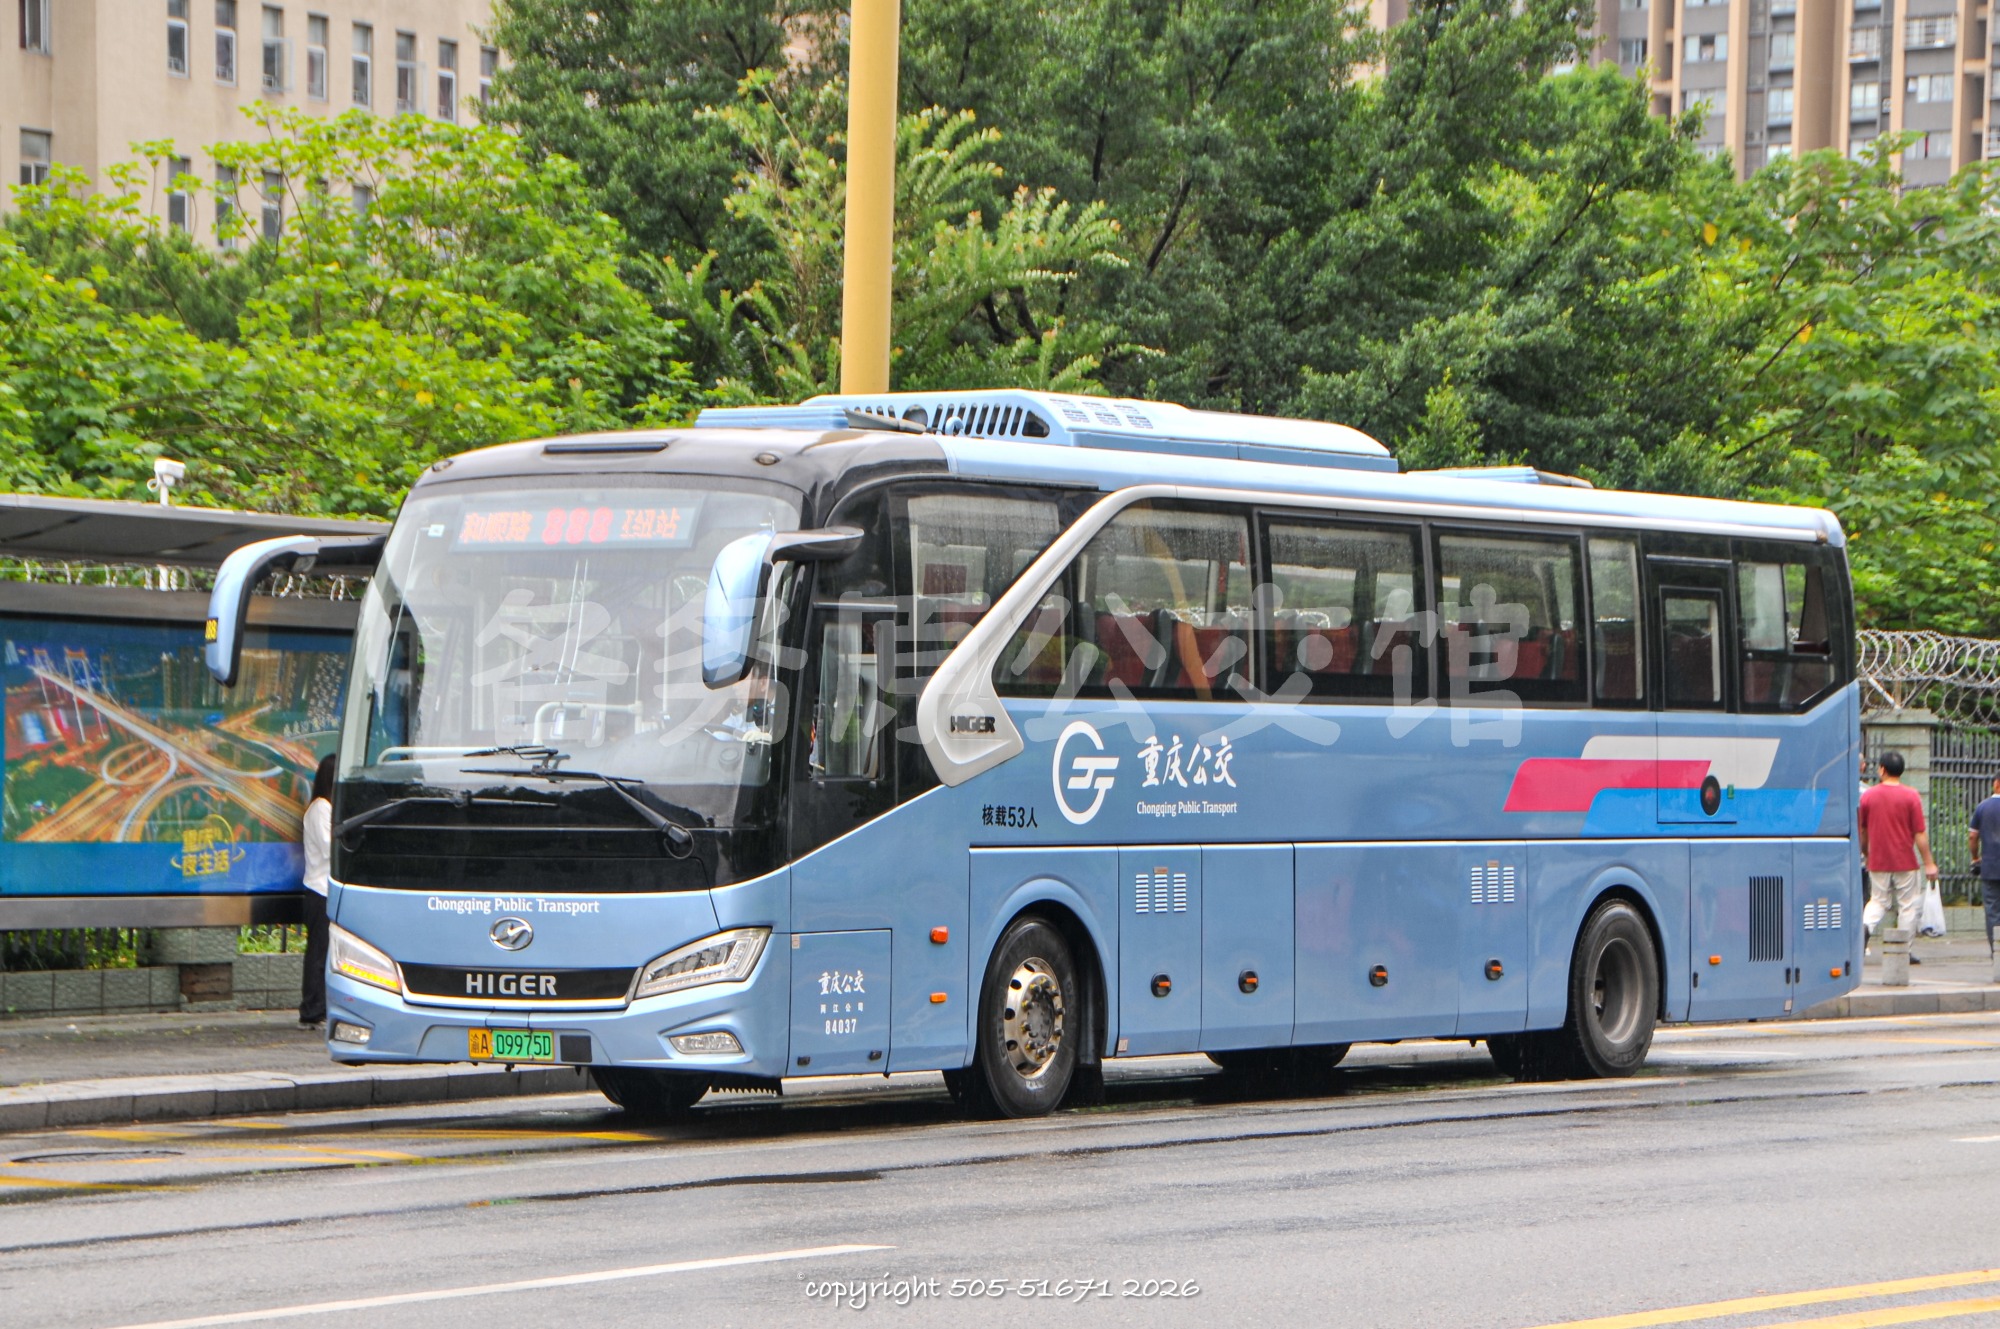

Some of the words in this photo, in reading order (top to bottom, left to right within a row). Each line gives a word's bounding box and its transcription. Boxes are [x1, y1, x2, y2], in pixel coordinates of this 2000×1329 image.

[541, 506, 614, 545] 888
[950, 715, 996, 734] HIGER
[1136, 735, 1238, 788] 重庆公交
[981, 804, 1039, 829] 核载53人
[1136, 801, 1177, 818] Chongqing
[1178, 801, 1201, 815] Public
[1203, 801, 1238, 815] Transport
[427, 896, 491, 914] Chongqing
[494, 897, 533, 912] Public
[536, 898, 600, 916] Transport
[465, 972, 558, 997] HIGER
[818, 969, 866, 996] 重庆公交
[825, 1018, 857, 1035] 84037
